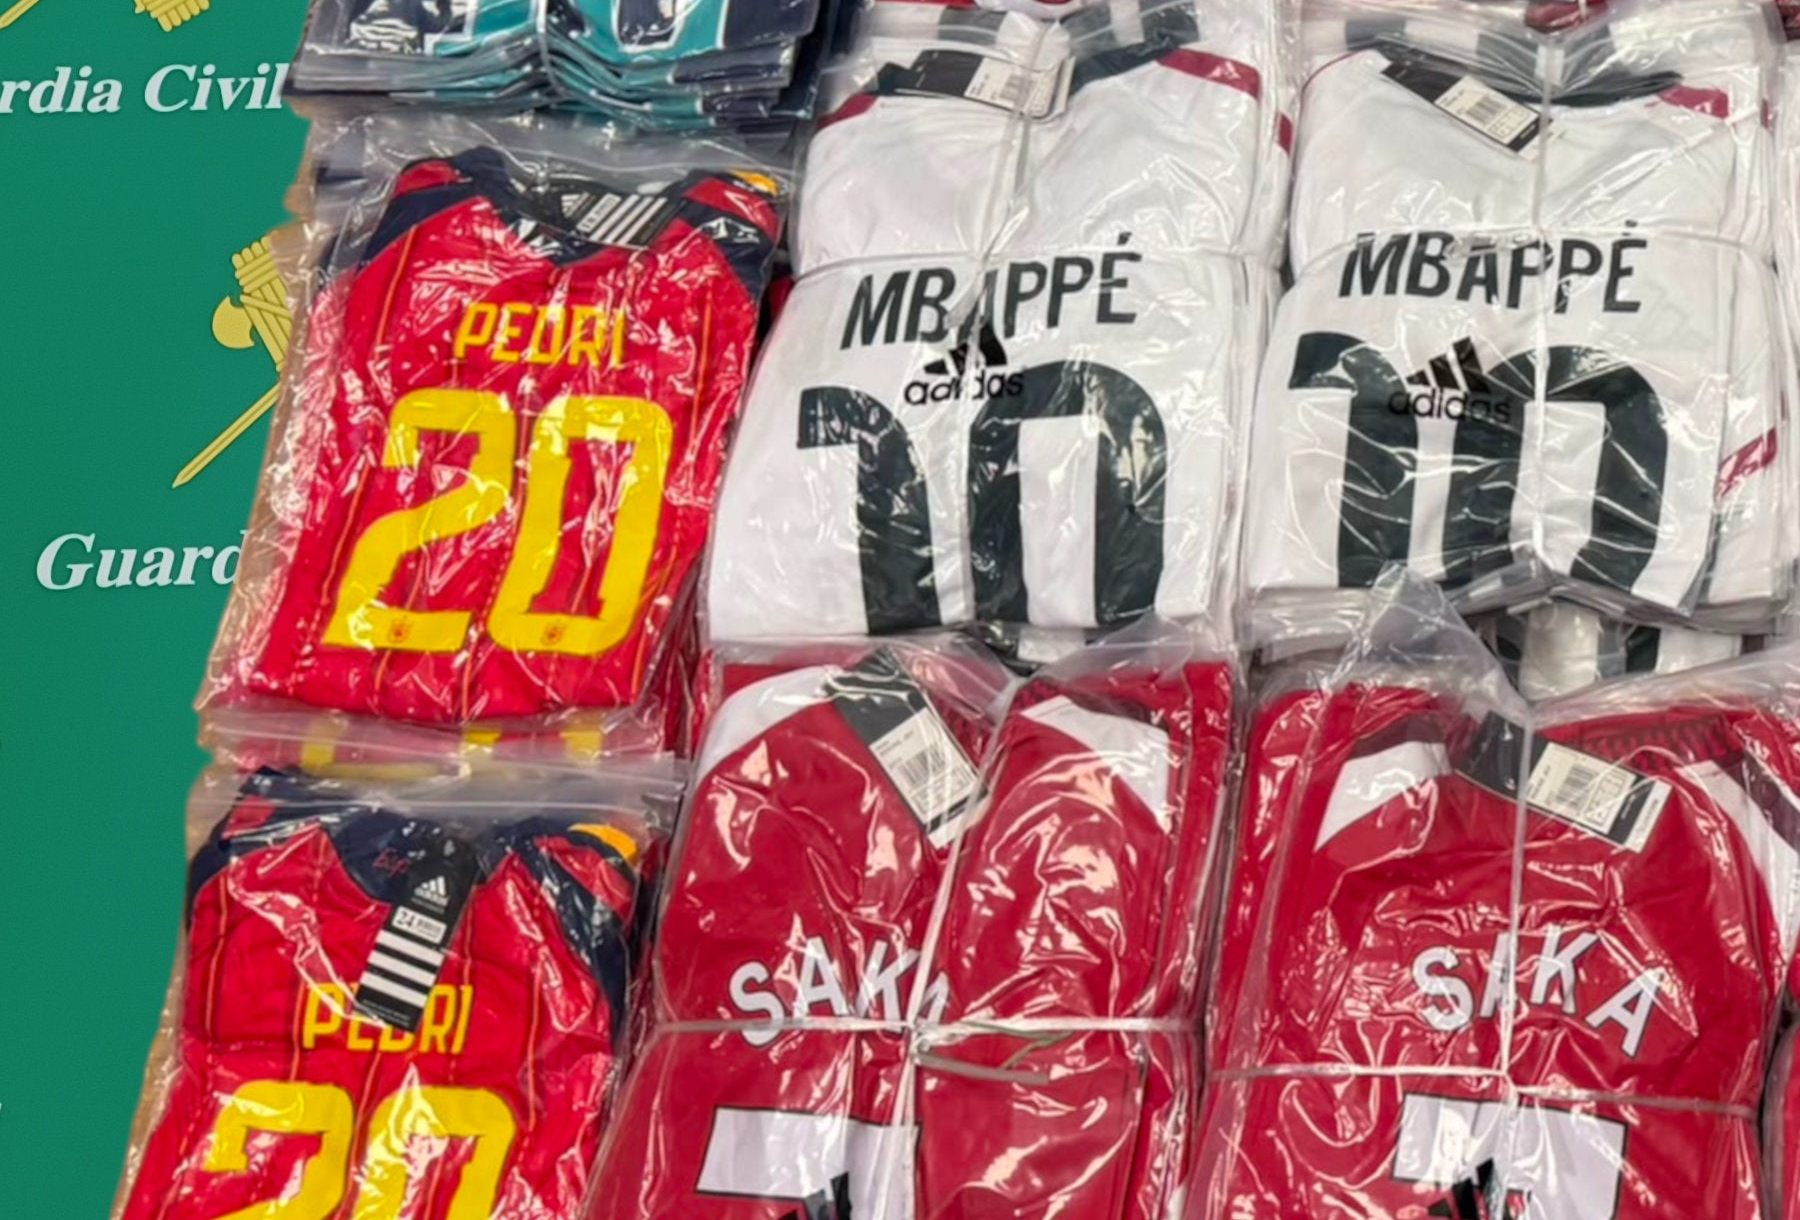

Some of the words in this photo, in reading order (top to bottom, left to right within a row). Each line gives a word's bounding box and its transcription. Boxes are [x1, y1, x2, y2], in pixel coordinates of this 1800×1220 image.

[144, 62, 287, 113] Civil
[1337, 218, 1648, 315] MBAPPÉ
[453, 302, 626, 369] PEDRI
[1388, 384, 1511, 425] adidas
[796, 360, 1170, 635] 10
[1288, 330, 1669, 593] 10
[35, 530, 251, 592] Guard
[321, 386, 673, 656] 20
